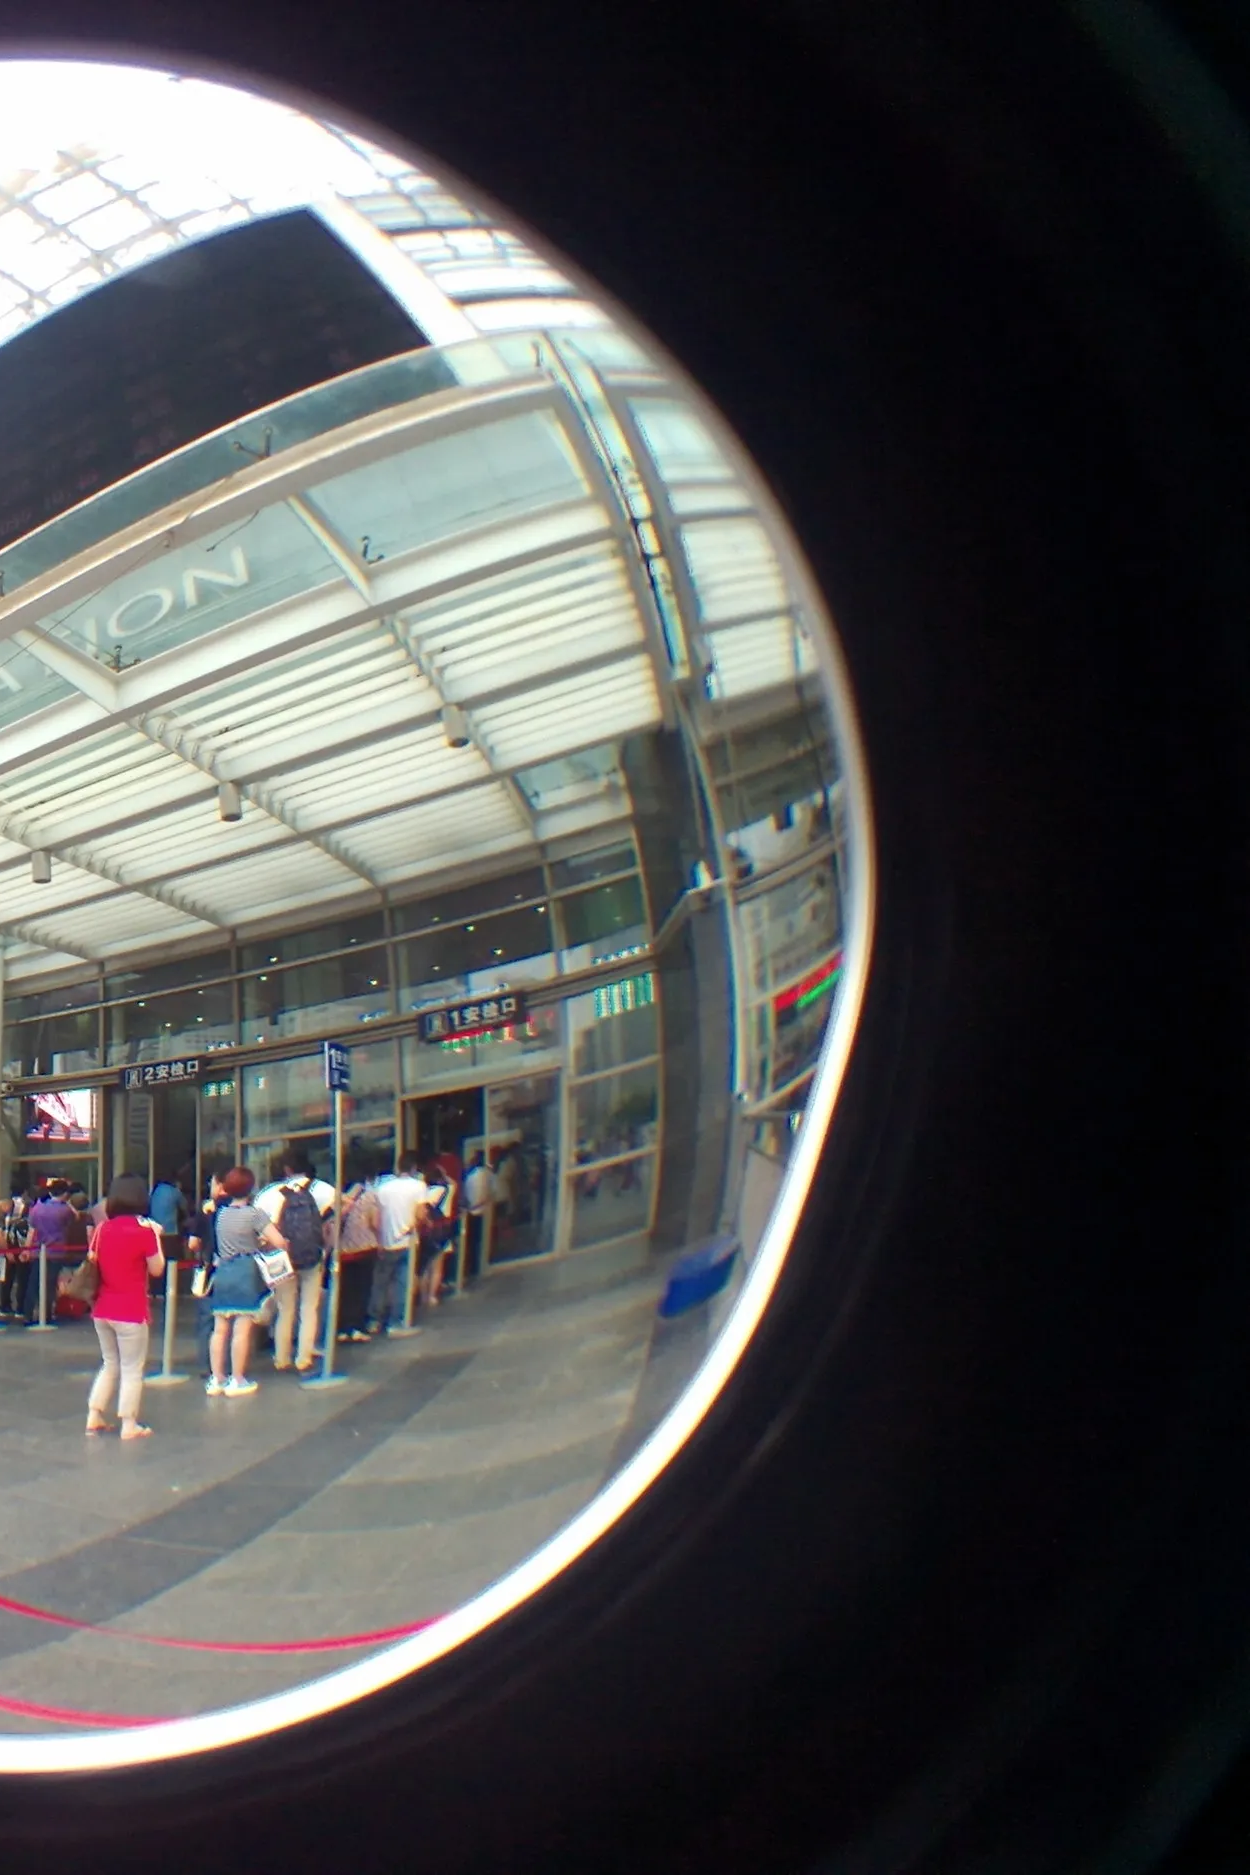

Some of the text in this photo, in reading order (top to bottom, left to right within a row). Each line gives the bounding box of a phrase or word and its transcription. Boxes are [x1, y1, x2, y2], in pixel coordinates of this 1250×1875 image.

[450, 998, 516, 1027] 1安检口
[144, 1060, 199, 1081] 2安检口
